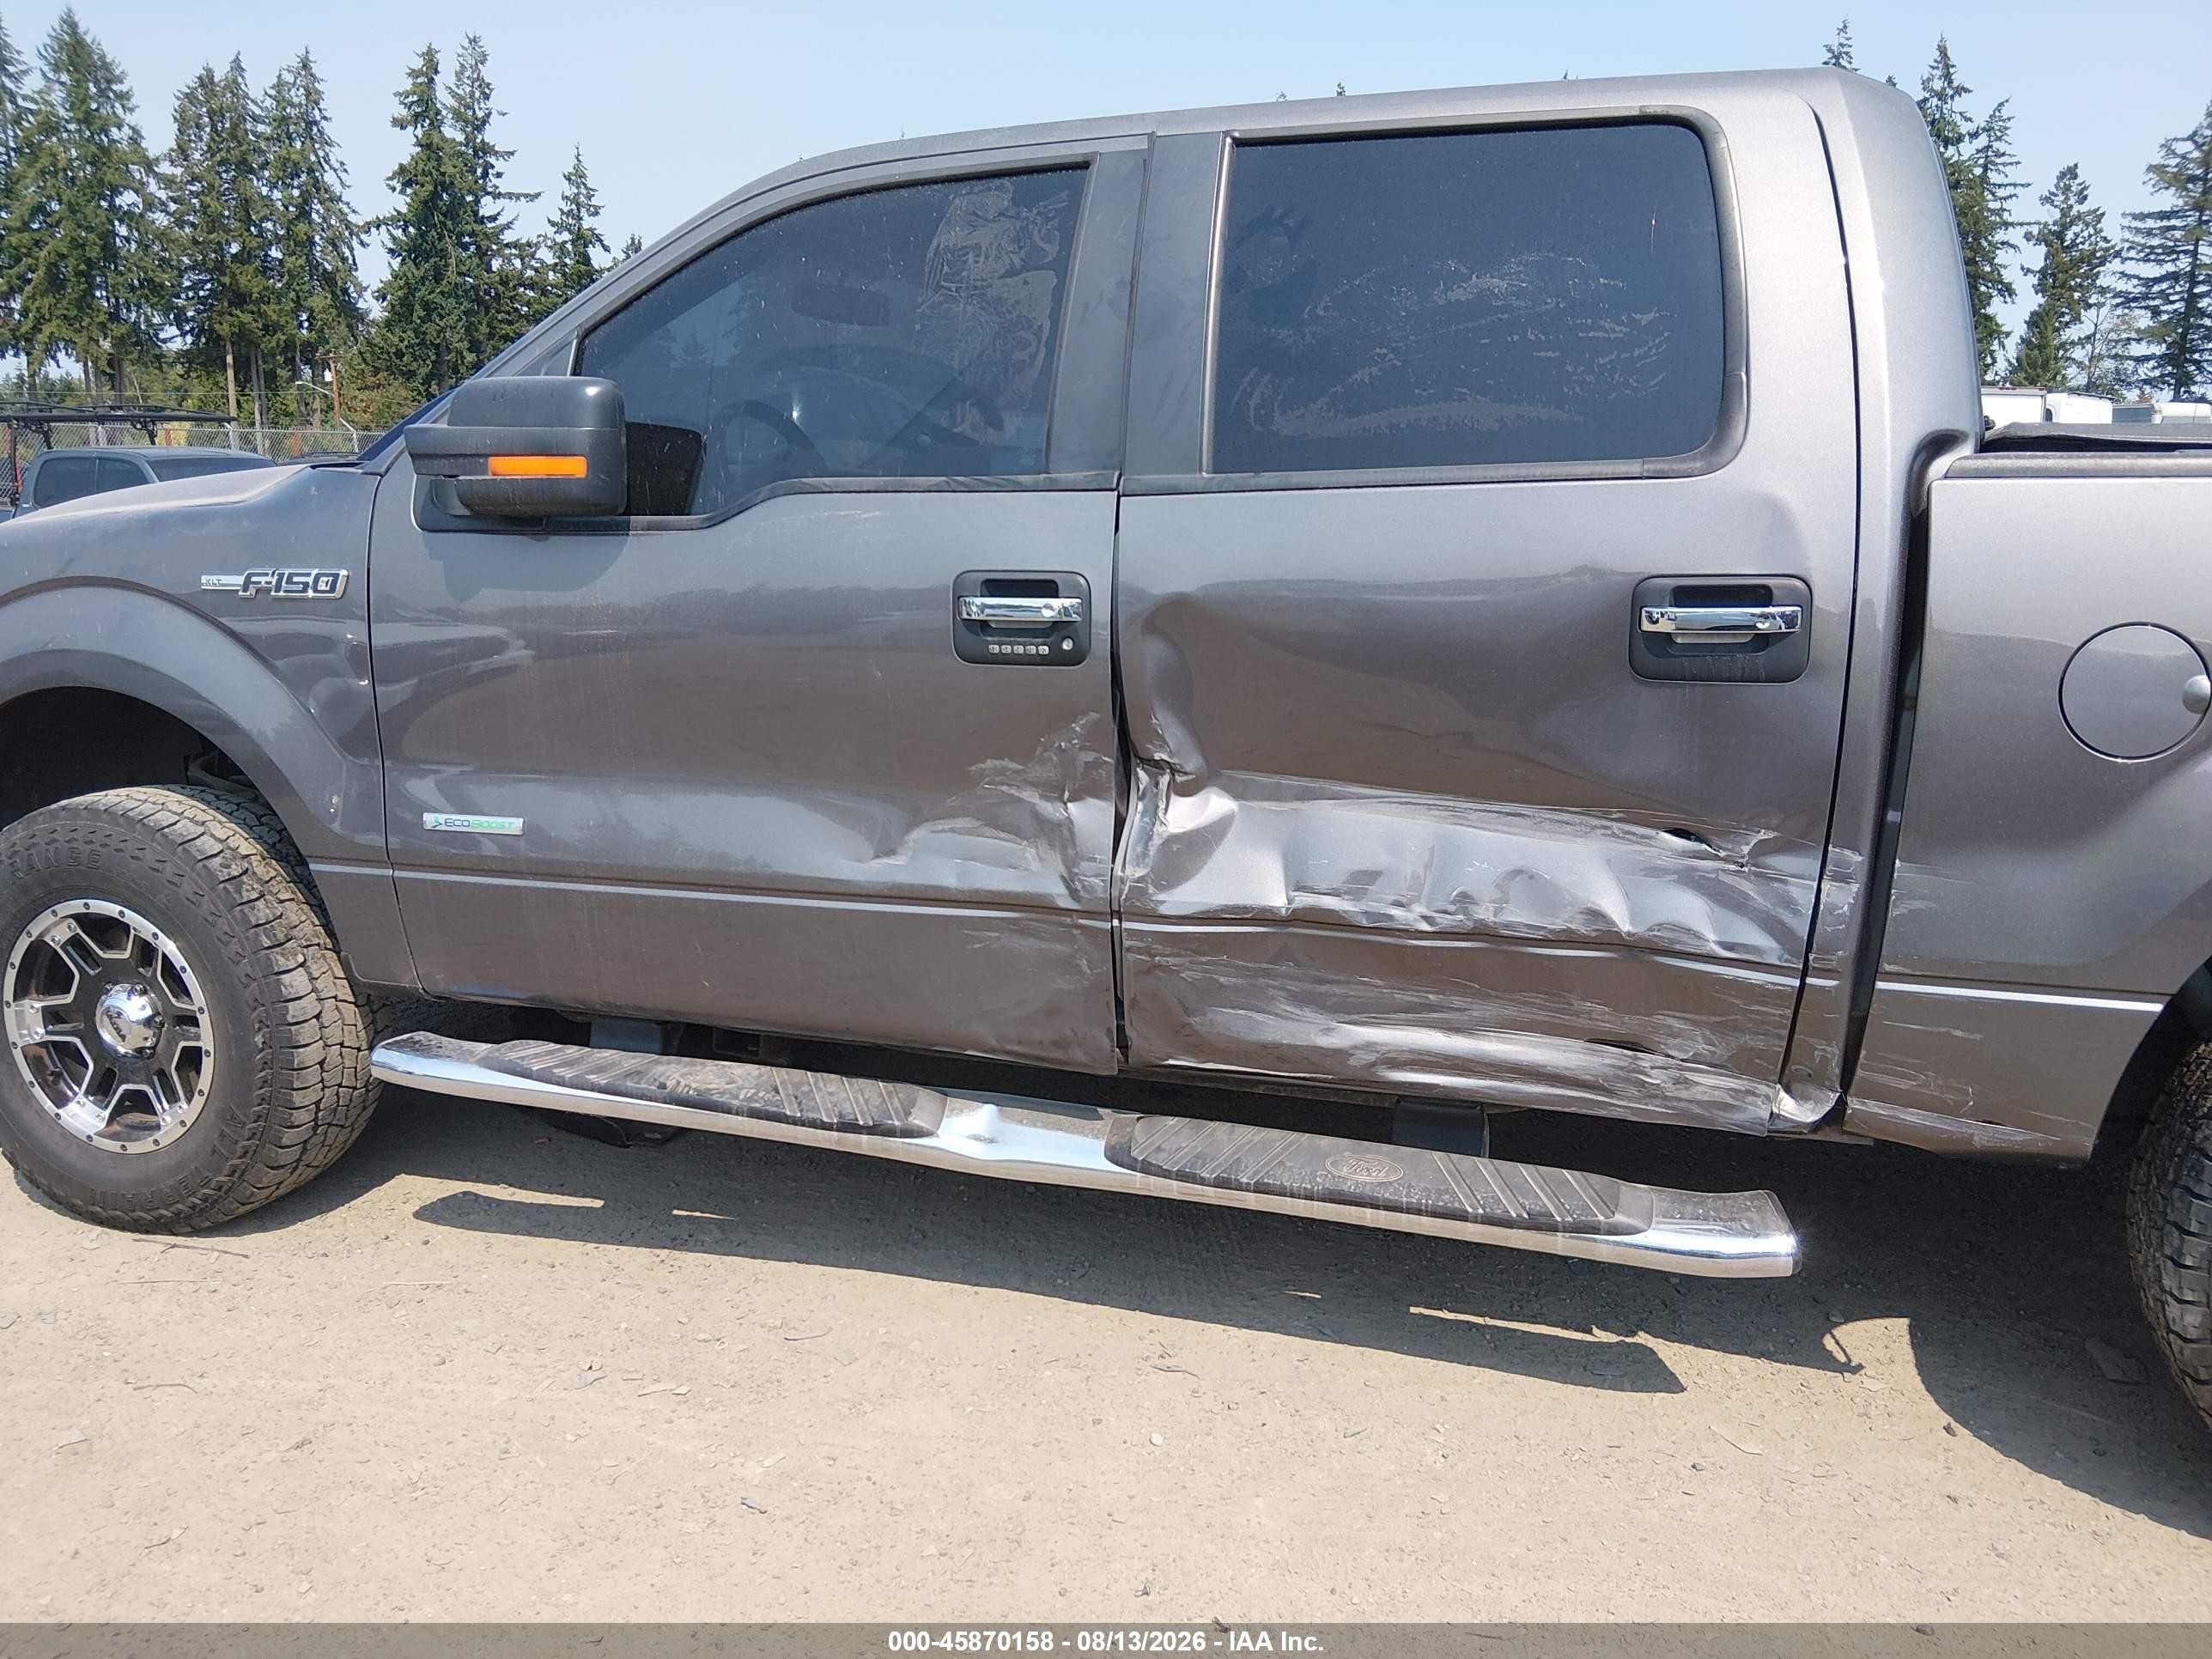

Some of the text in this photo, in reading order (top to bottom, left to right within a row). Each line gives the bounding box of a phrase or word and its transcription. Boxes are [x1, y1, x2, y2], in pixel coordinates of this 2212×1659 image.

[204, 568, 349, 599] XLT F-150
[210, 1103, 246, 1162] ALL
